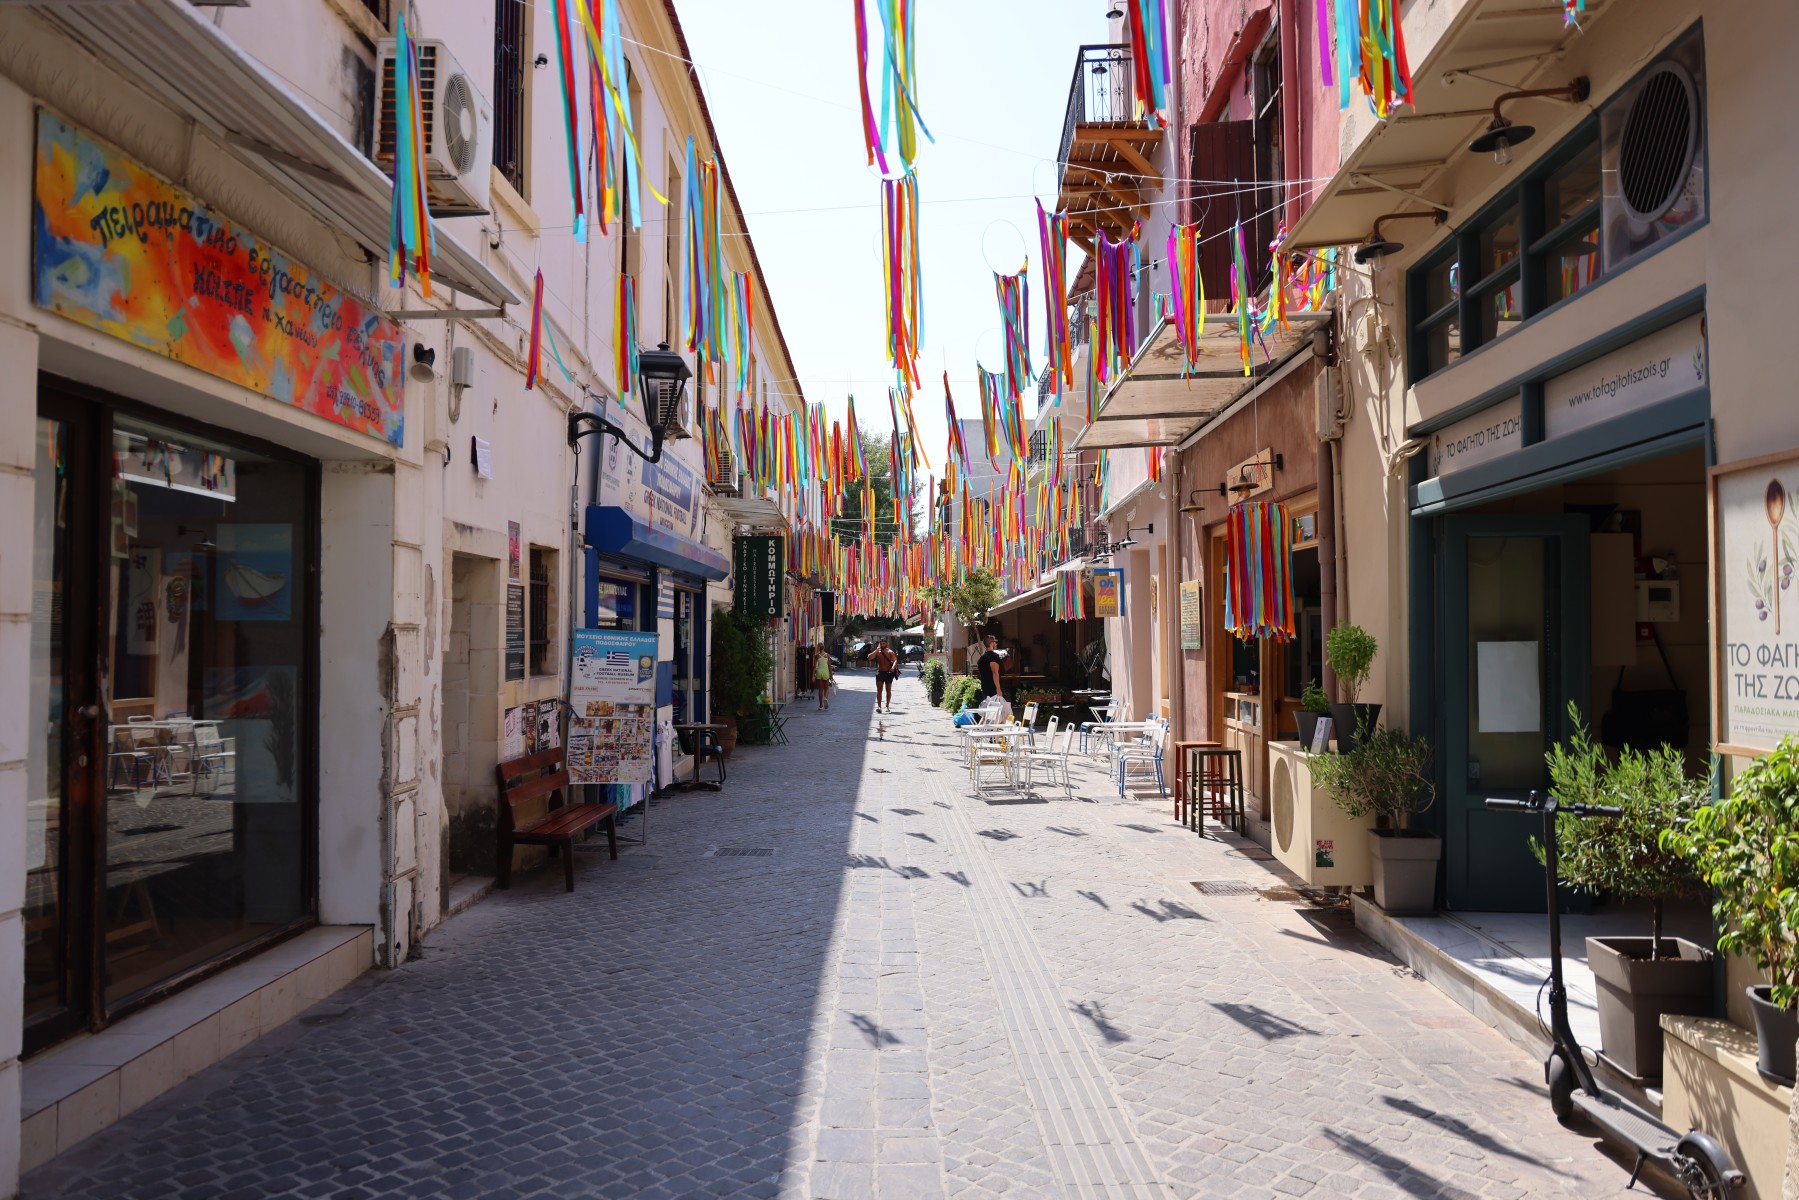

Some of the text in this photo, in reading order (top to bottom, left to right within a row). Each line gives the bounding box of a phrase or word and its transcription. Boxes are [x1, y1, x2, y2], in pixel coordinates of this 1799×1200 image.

[1568, 356, 1671, 408] www.tofagitotiszois.gr
[1446, 443, 1455, 459] ΤΟ
[1456, 433, 1485, 455] ΦΑΓΗΤΟ
[1486, 423, 1501, 443] ΤΗΣ
[768, 539, 776, 615] ΚΟΜΜΩΤΗΡΙΟ
[1727, 643, 1751, 667] ΤΟ
[1734, 673, 1768, 698] ΤΗΣ
[1734, 705, 1780, 717] ΠΑΡΑΔΟΣΙΑΚΑ
